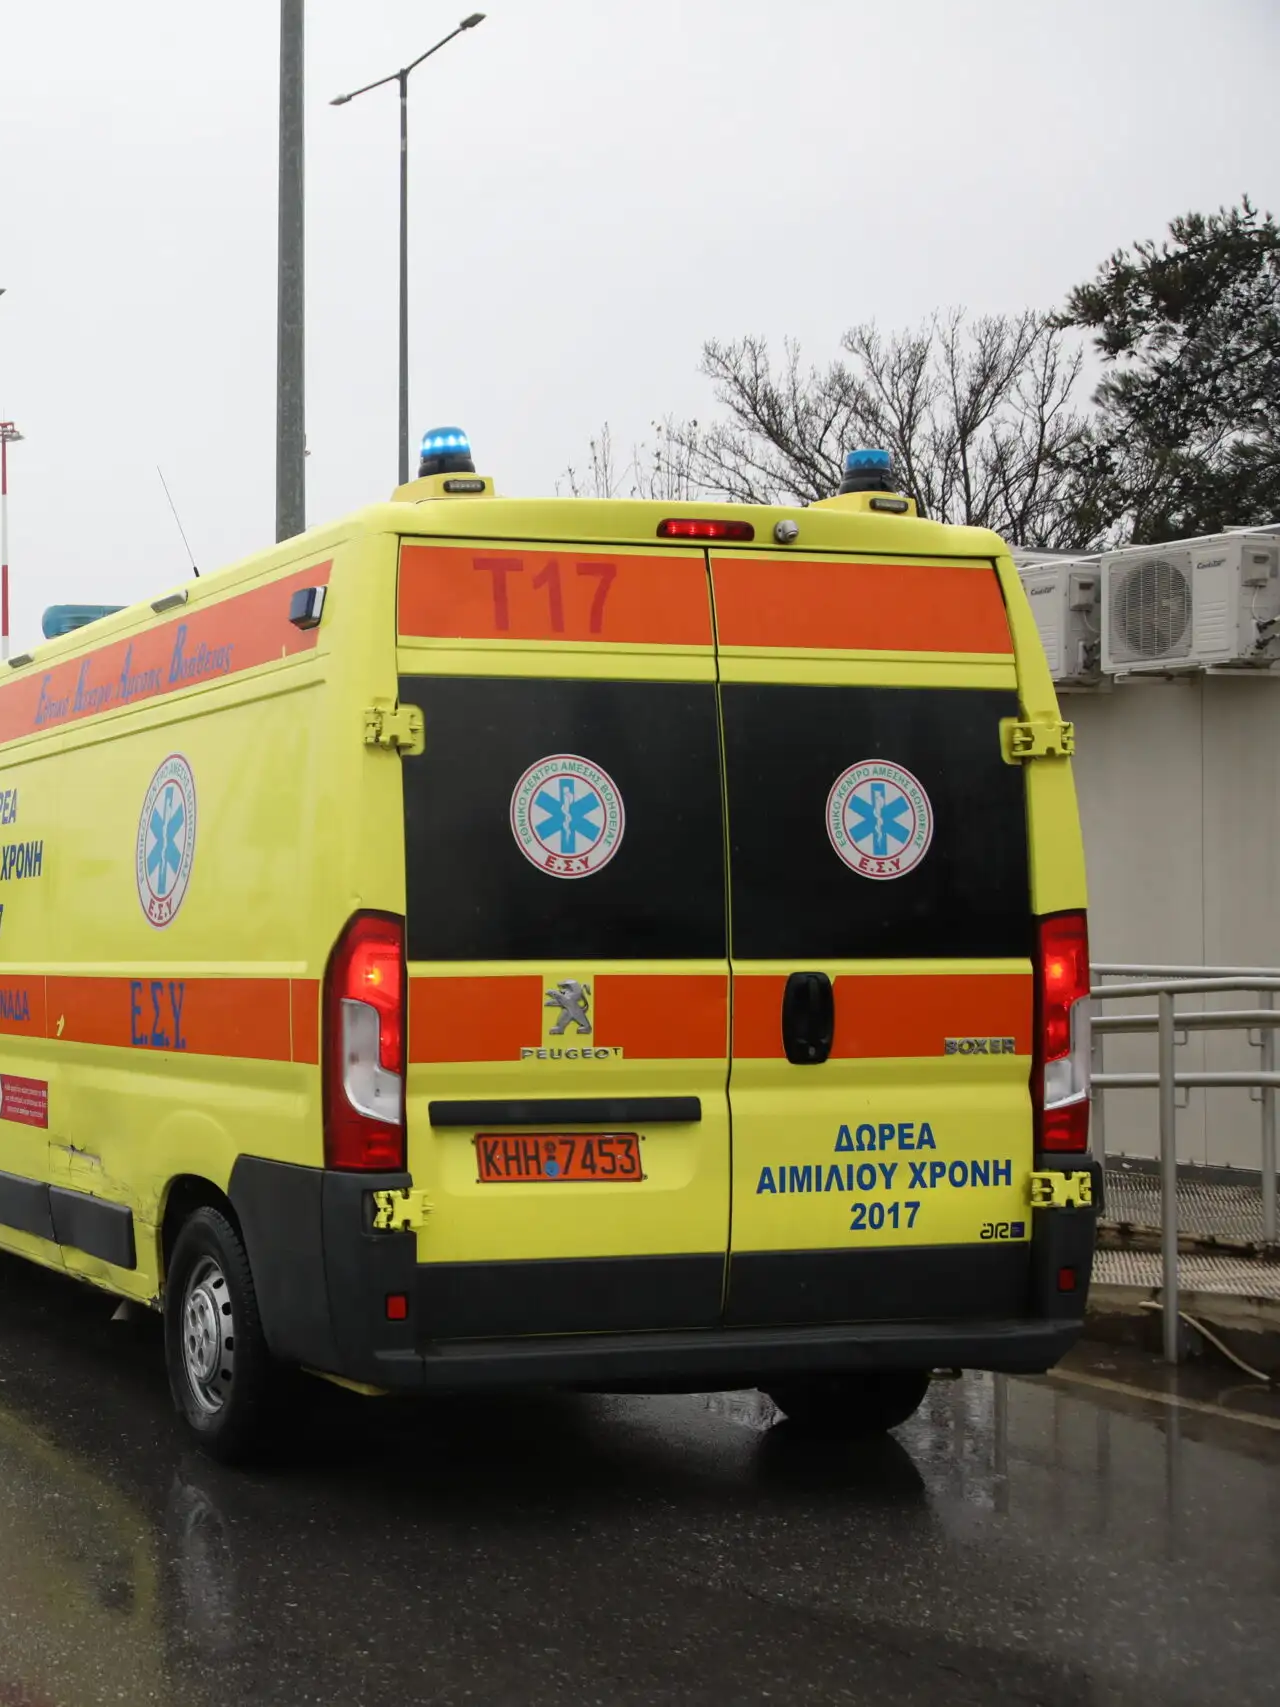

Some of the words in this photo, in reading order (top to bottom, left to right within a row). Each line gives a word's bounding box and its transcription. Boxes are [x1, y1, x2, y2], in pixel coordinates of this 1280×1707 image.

[472, 556, 618, 634] T17
[523, 763, 558, 795] ΚΕΝΤΡΟ
[561, 762, 602, 785] ΑΜΕΣΗΣ
[837, 767, 870, 799] ΚΕΝΤΡΟ
[517, 797, 533, 845] ΕΘΝΙΚΟ
[600, 783, 618, 847] ΒΟΗΘΕΙΑΣ
[0, 840, 43, 882] ΧΡΟΝΗ
[521, 1047, 620, 1060] PEUGEOT
[944, 1038, 1015, 1055] BOXER
[833, 1122, 937, 1153] ΔΩΡΕΑ
[558, 1138, 636, 1175] 7453
[756, 1161, 896, 1194] ΑΙΜΙΛΙΟΥ
[907, 1159, 1013, 1189] ΧΡΟΝΗ
[849, 1201, 921, 1231] 2017
